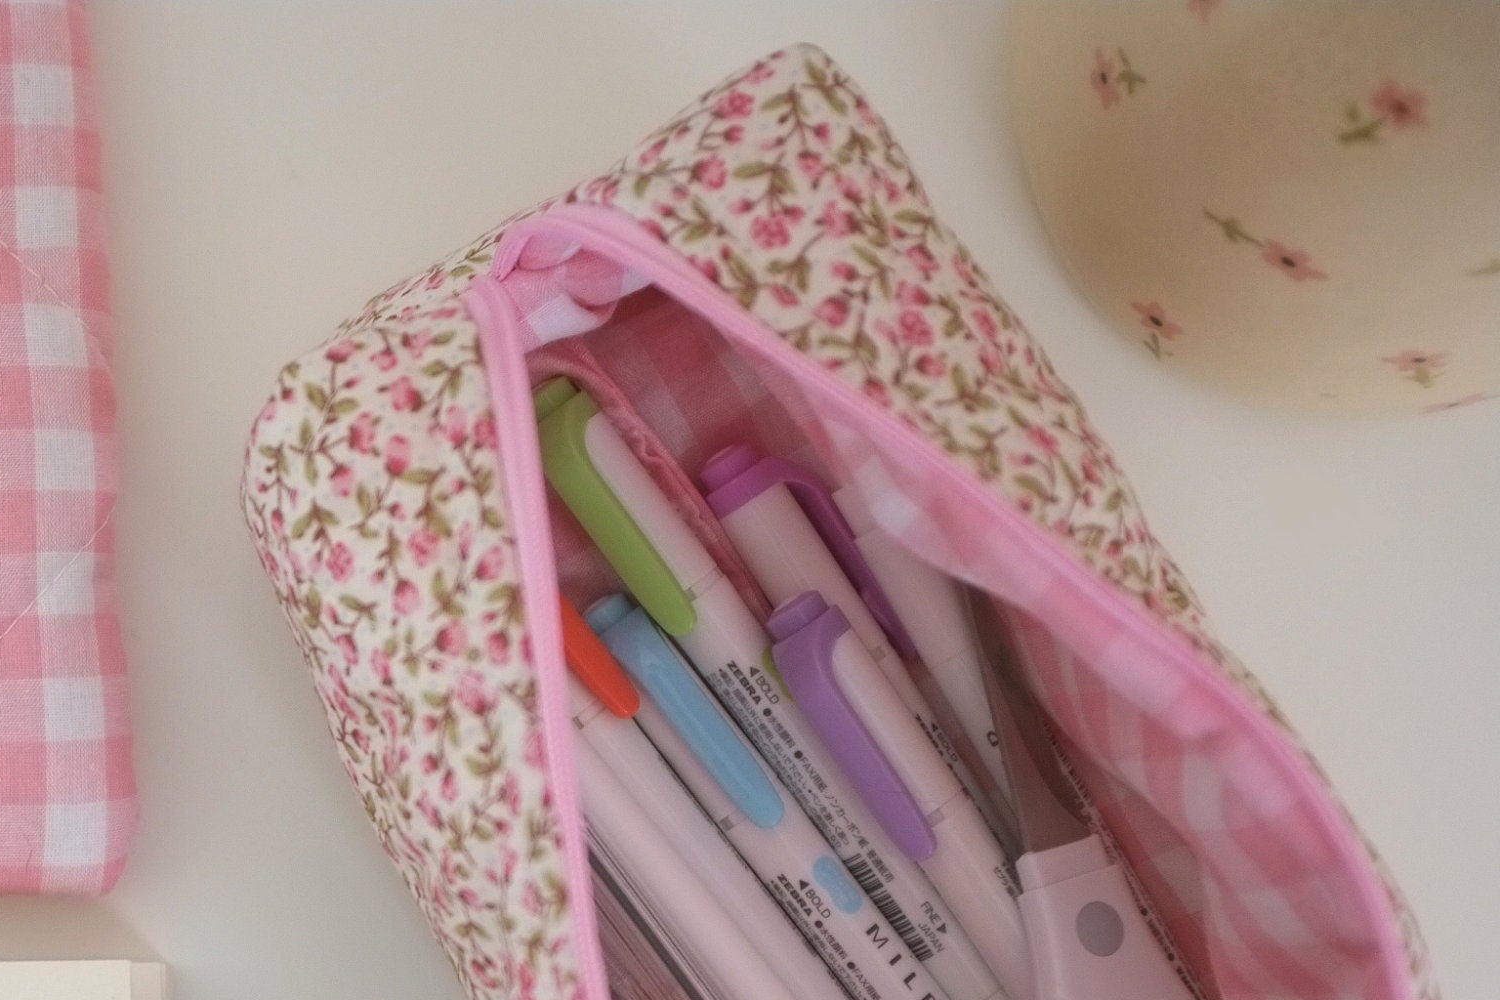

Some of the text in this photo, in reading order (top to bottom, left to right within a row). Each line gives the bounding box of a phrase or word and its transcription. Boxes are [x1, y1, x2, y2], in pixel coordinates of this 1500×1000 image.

[725, 659, 763, 705] ZEBRA
[753, 674, 780, 706] BOLD
[776, 872, 813, 917] ZEBRA
[804, 887, 832, 920] BOLD
[919, 900, 941, 925] FINE
[916, 919, 945, 954] JAPAN
